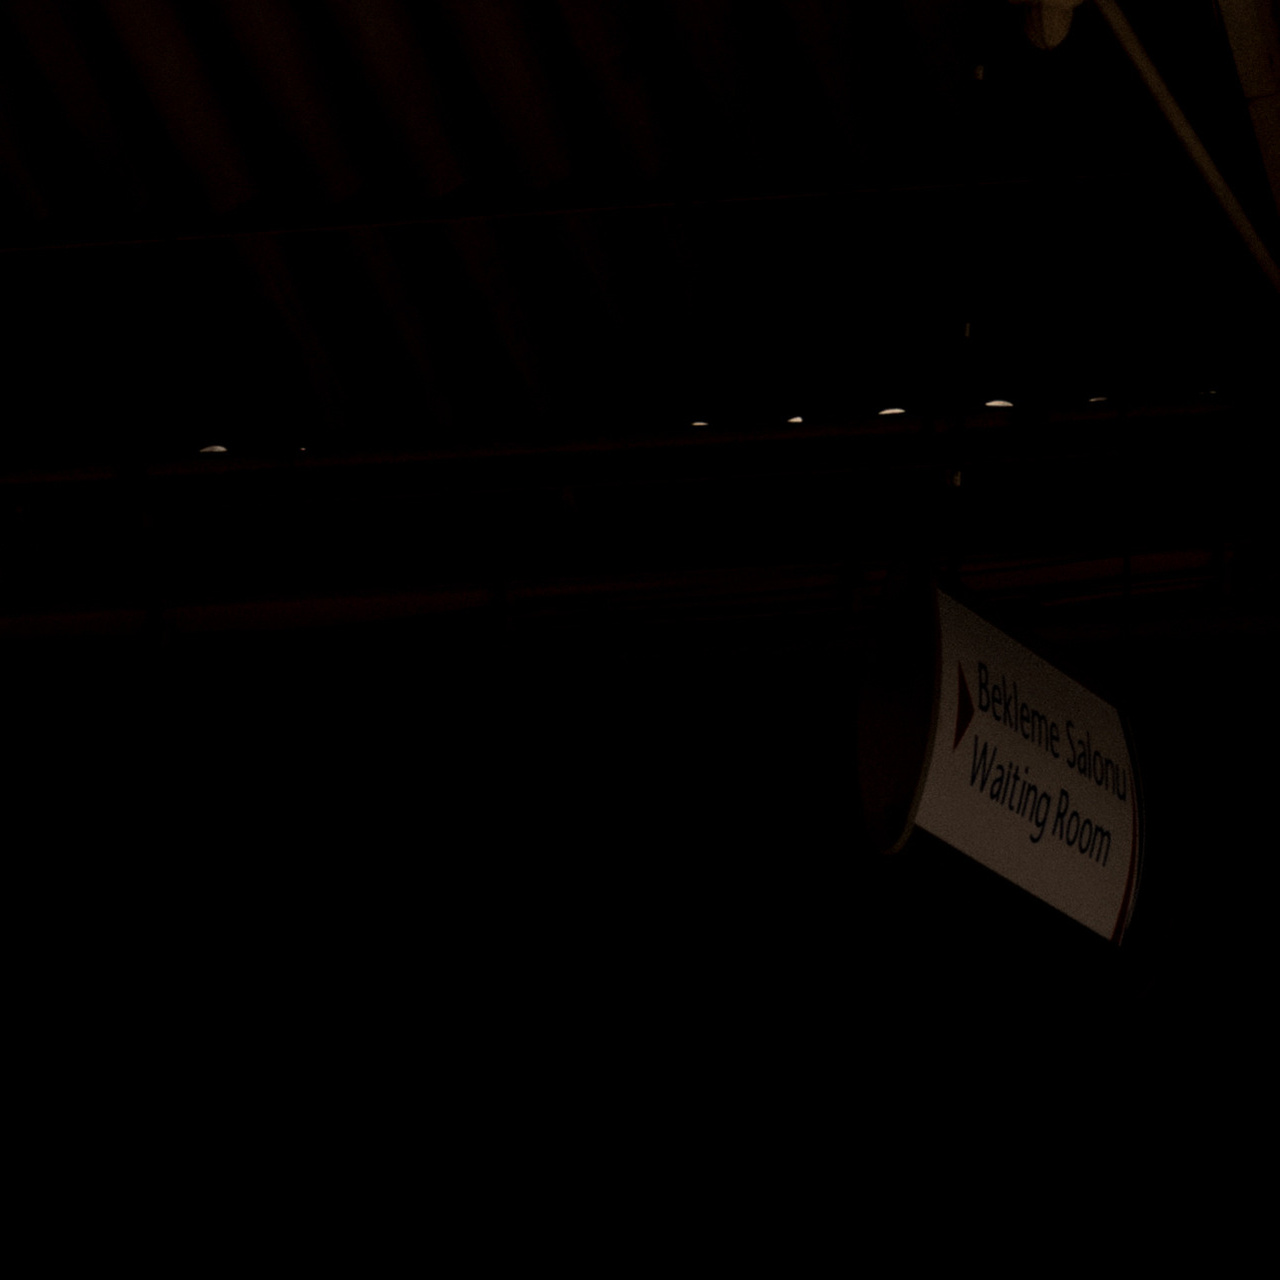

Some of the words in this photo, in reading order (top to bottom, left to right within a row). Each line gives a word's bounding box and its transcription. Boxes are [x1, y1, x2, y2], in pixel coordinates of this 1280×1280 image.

[977, 661, 1061, 759] Bekleme
[1066, 719, 1127, 802] Salonu
[970, 734, 1051, 844] Waiting
[1052, 788, 1112, 868] Room
